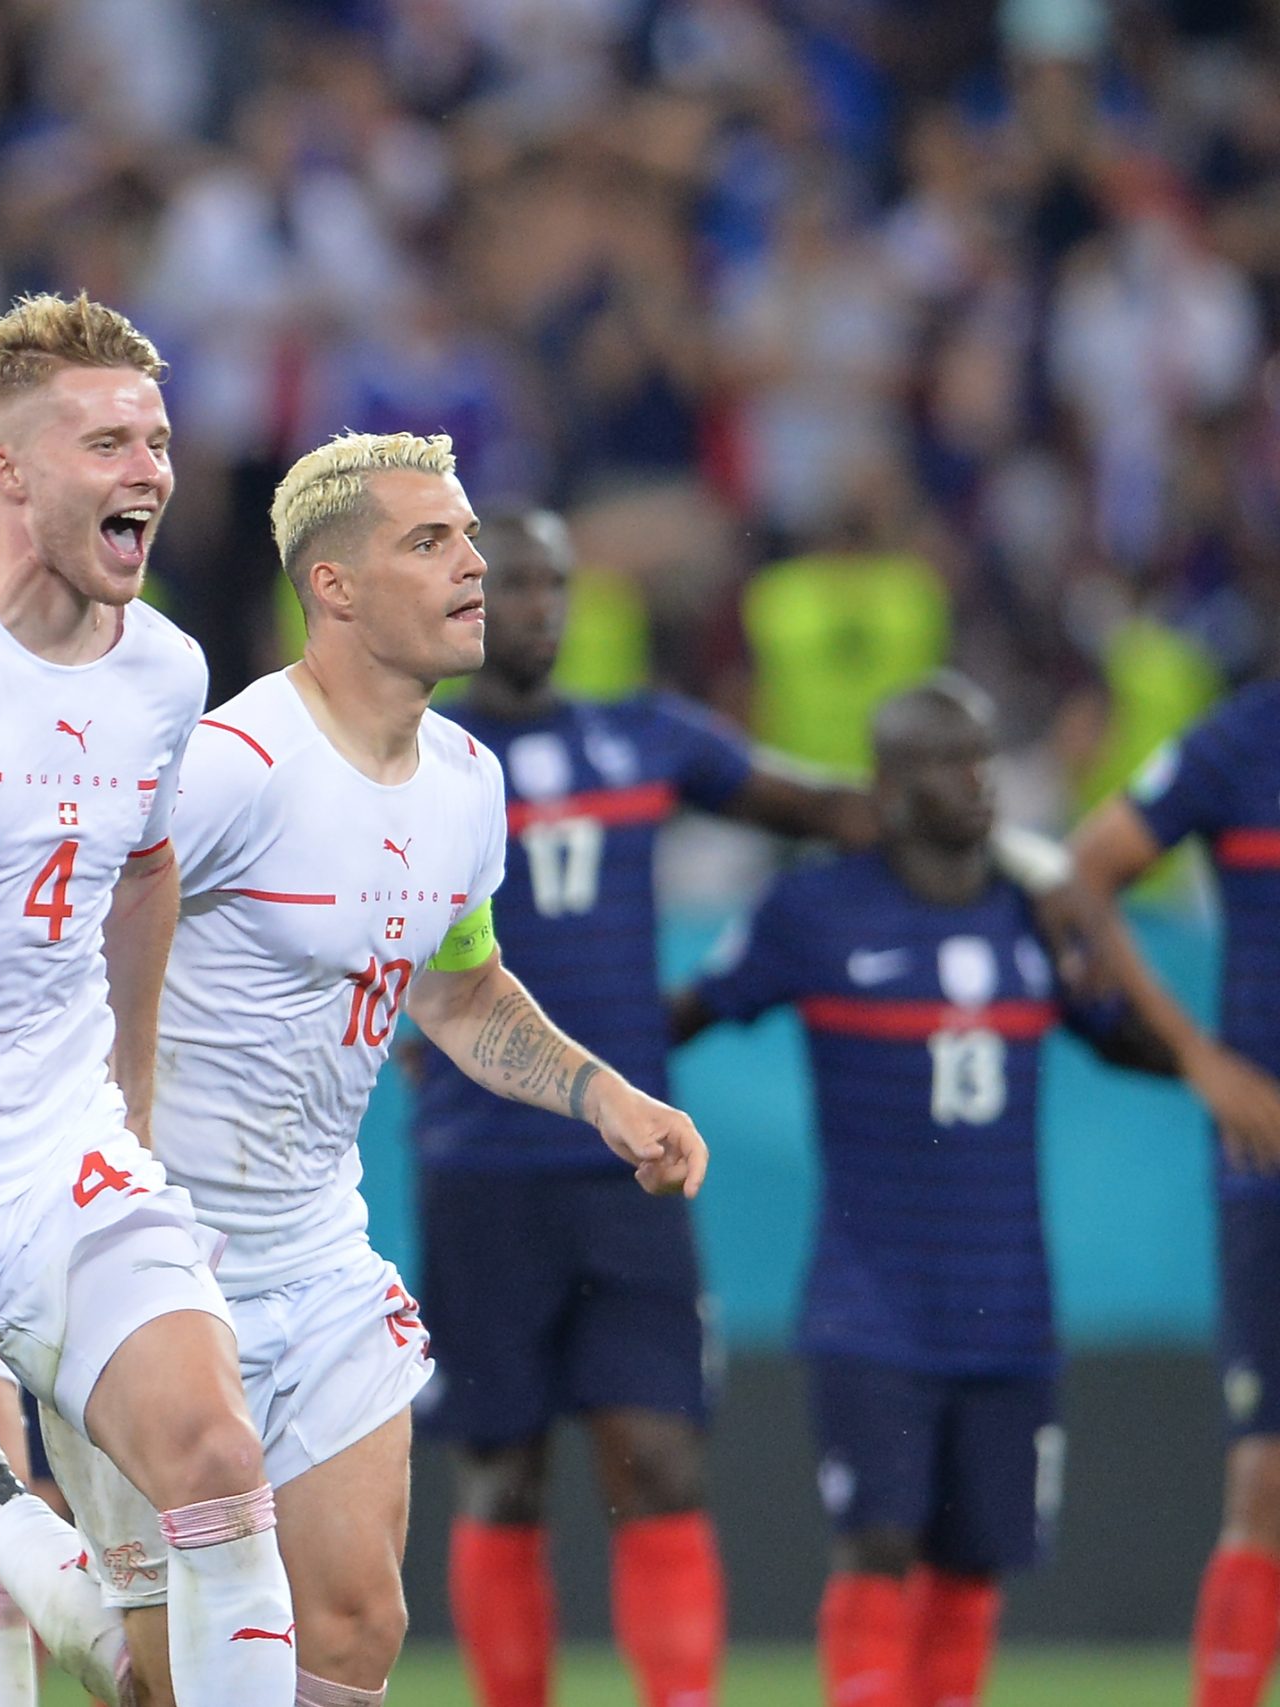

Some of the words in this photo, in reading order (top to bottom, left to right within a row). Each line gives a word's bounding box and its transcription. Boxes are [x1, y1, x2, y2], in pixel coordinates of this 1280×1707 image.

[25, 774, 119, 788] suisse
[23, 840, 79, 941] 4
[360, 890, 439, 903] suisse
[521, 818, 602, 917] 17
[341, 956, 413, 1047] 10
